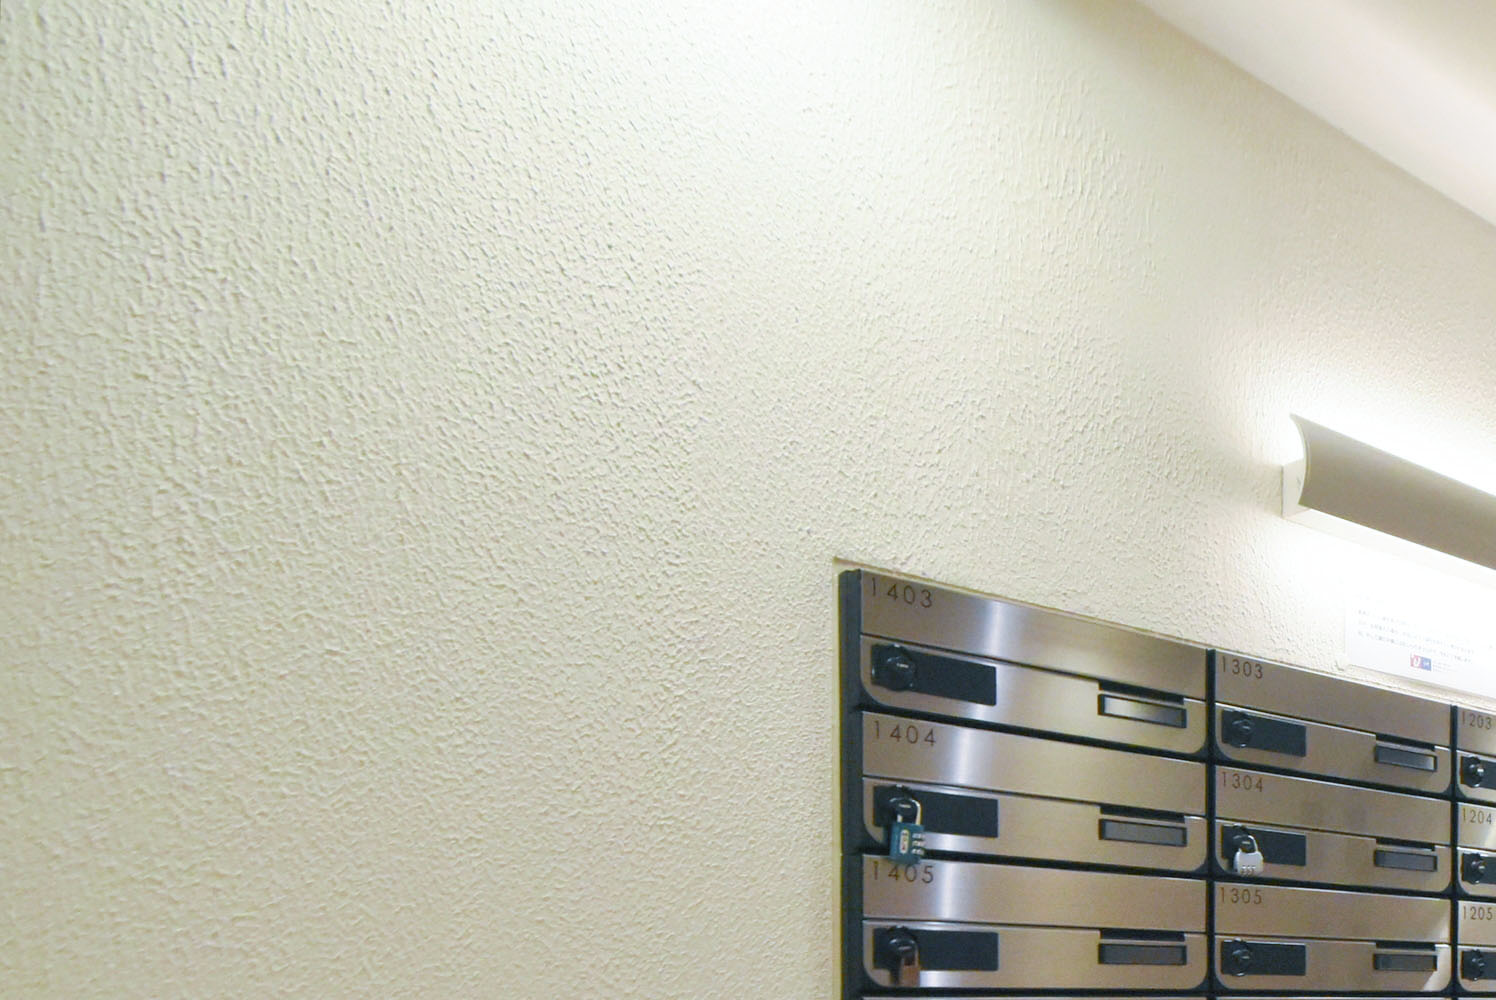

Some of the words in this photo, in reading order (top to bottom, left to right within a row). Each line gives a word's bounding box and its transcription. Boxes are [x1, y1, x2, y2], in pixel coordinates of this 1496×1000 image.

[872, 579, 933, 609] 1403
[1221, 655, 1264, 680] 1303
[1462, 710, 1493, 731] 1203
[873, 719, 937, 747] 1404
[1221, 771, 1264, 793] 1304
[1462, 808, 1493, 826] 1204
[872, 861, 934, 884] 1405
[1220, 887, 1263, 905] 1305
[1462, 905, 1494, 921] 1205
